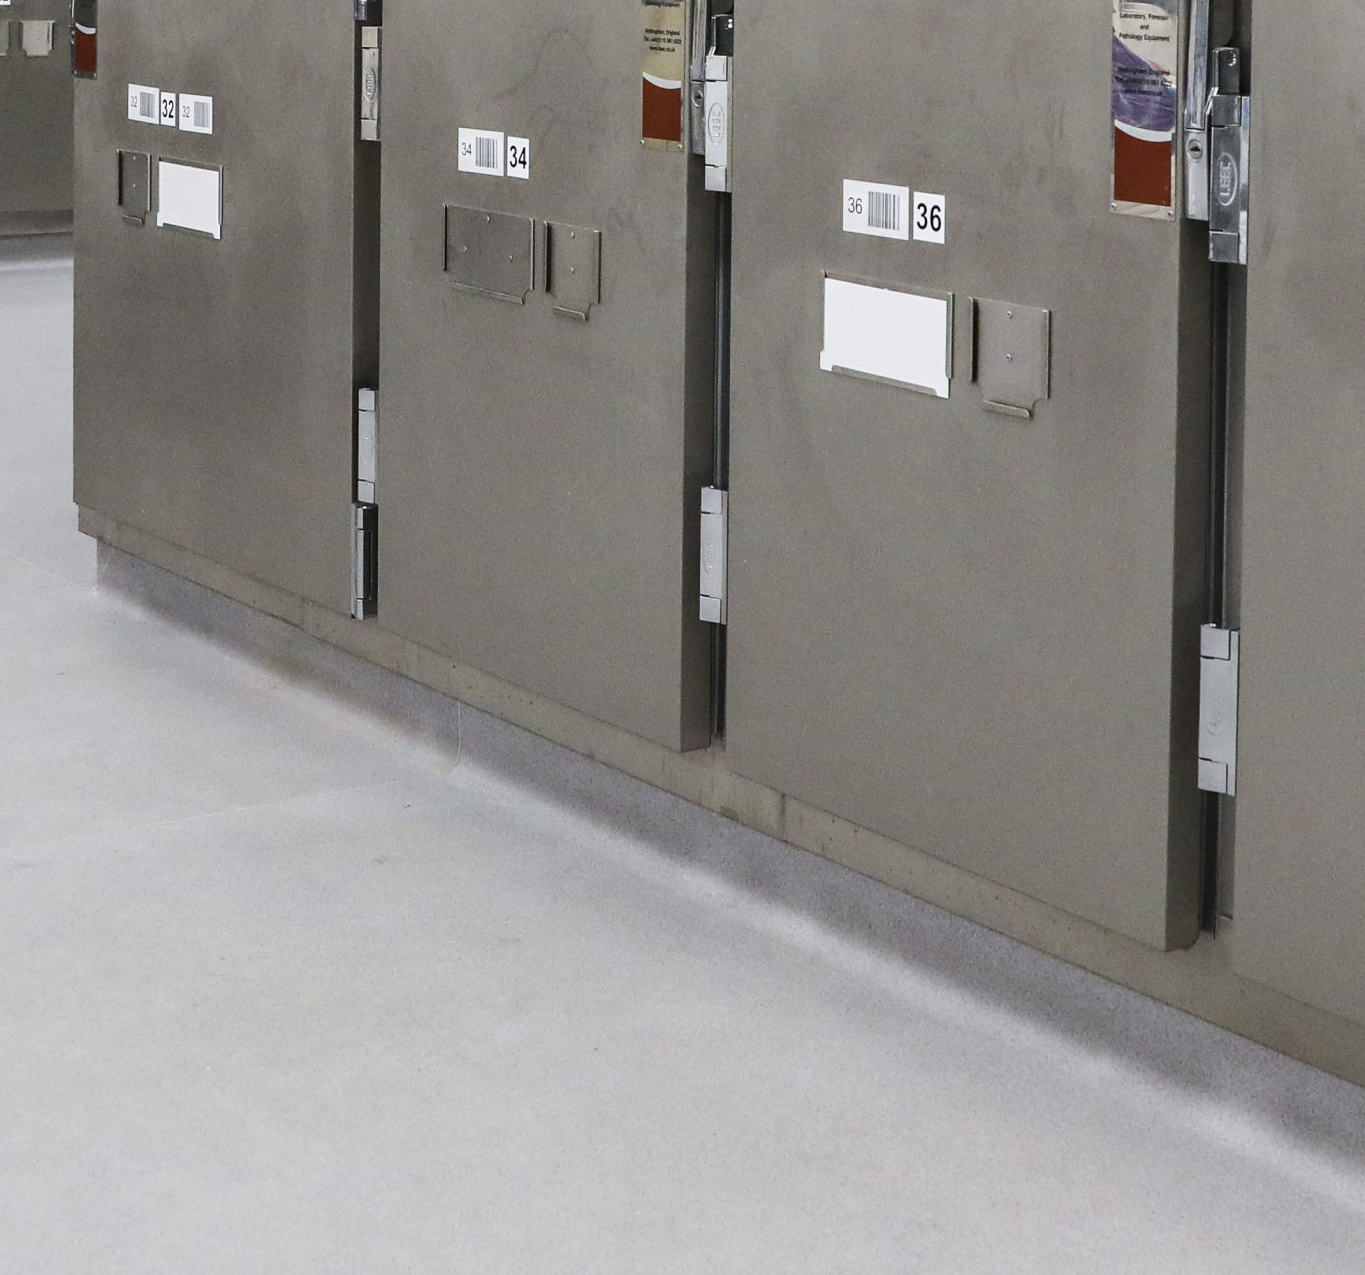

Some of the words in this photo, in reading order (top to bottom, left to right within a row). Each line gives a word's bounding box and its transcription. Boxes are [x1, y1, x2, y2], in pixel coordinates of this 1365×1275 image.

[161, 97, 176, 120] 32
[182, 105, 191, 119] 32
[461, 142, 472, 156] 34
[508, 144, 529, 171] 34
[1219, 161, 1231, 196] LEEC
[847, 196, 863, 215] 36
[915, 201, 943, 234] 36
